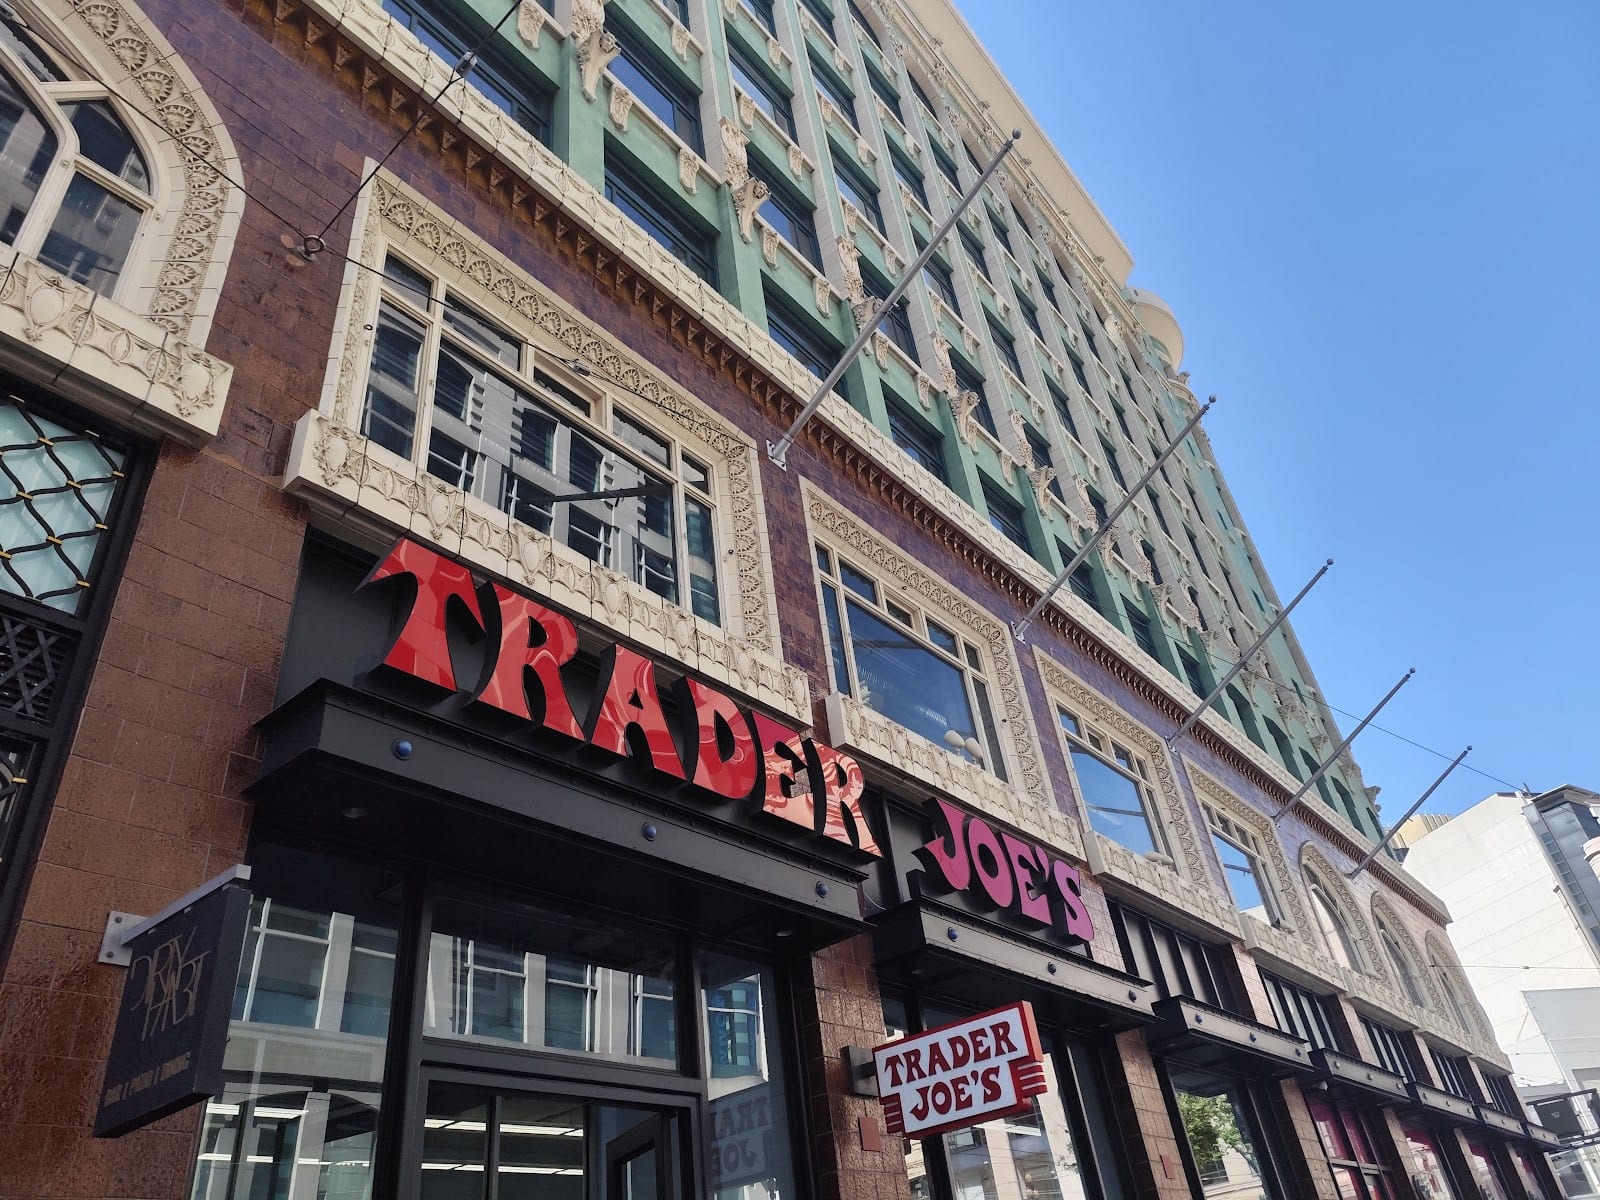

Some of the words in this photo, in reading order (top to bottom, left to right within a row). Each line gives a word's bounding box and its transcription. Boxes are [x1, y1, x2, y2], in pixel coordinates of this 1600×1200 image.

[370, 537, 883, 859] TRADER
[920, 798, 1095, 942] JOE'S
[884, 1020, 1018, 1088] TRADER
[910, 1066, 1002, 1121] JOE'S
